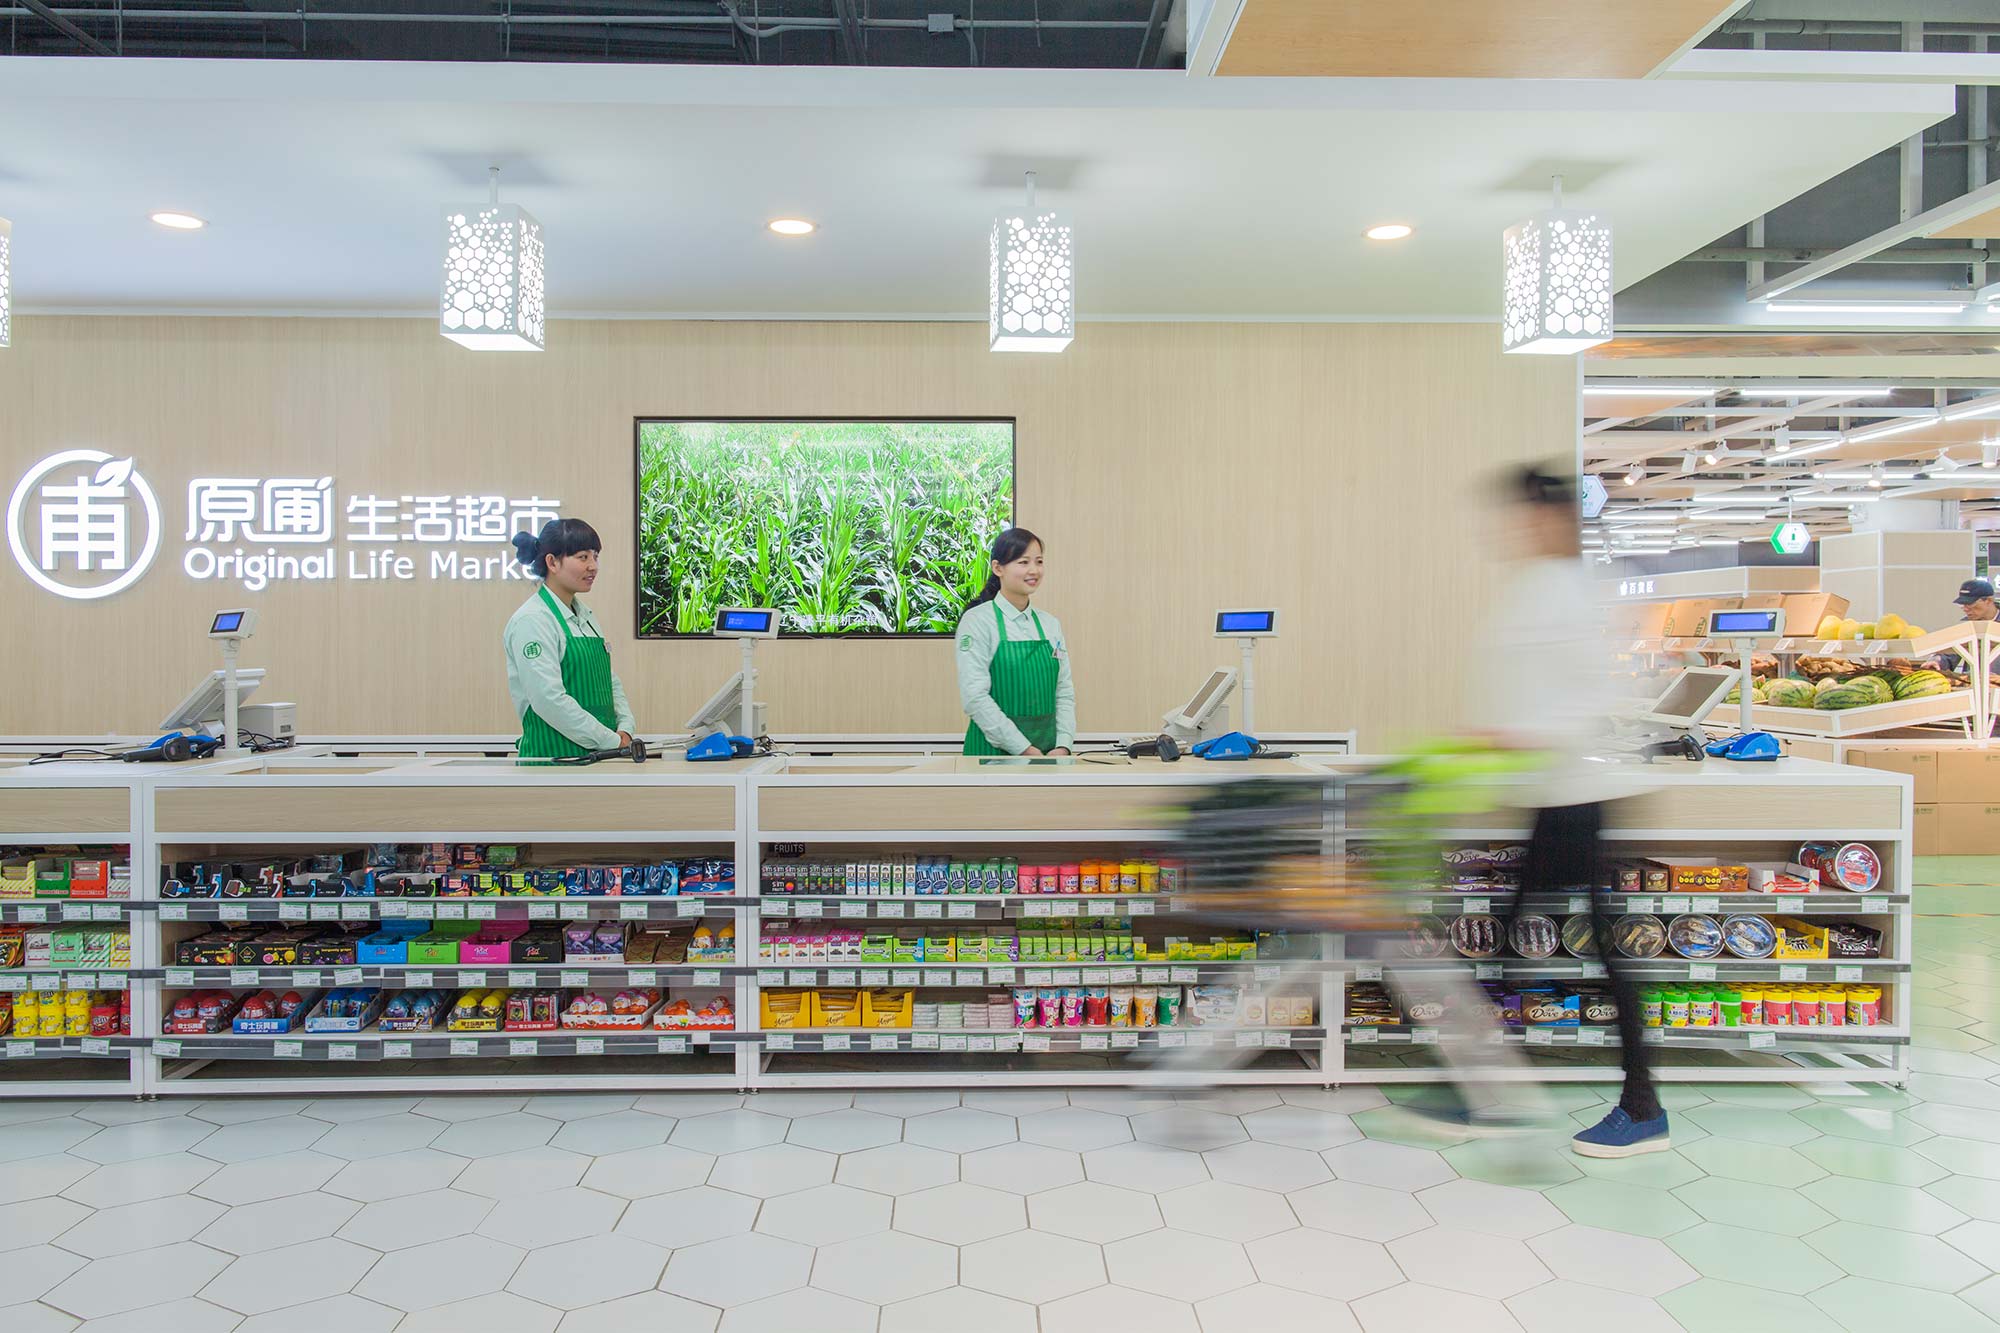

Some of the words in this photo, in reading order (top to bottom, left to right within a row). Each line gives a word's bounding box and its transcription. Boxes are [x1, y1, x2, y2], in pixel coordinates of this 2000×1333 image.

[347, 494, 561, 542] 生活超市
[184, 548, 334, 591] Original
[350, 550, 414, 579] Life
[774, 844, 804, 853] FRUITS
[1679, 875, 1694, 884] bon
[1706, 876, 1721, 884] bon
[1531, 1008, 1559, 1018] Dove
[1588, 1009, 1616, 1018] Dove
